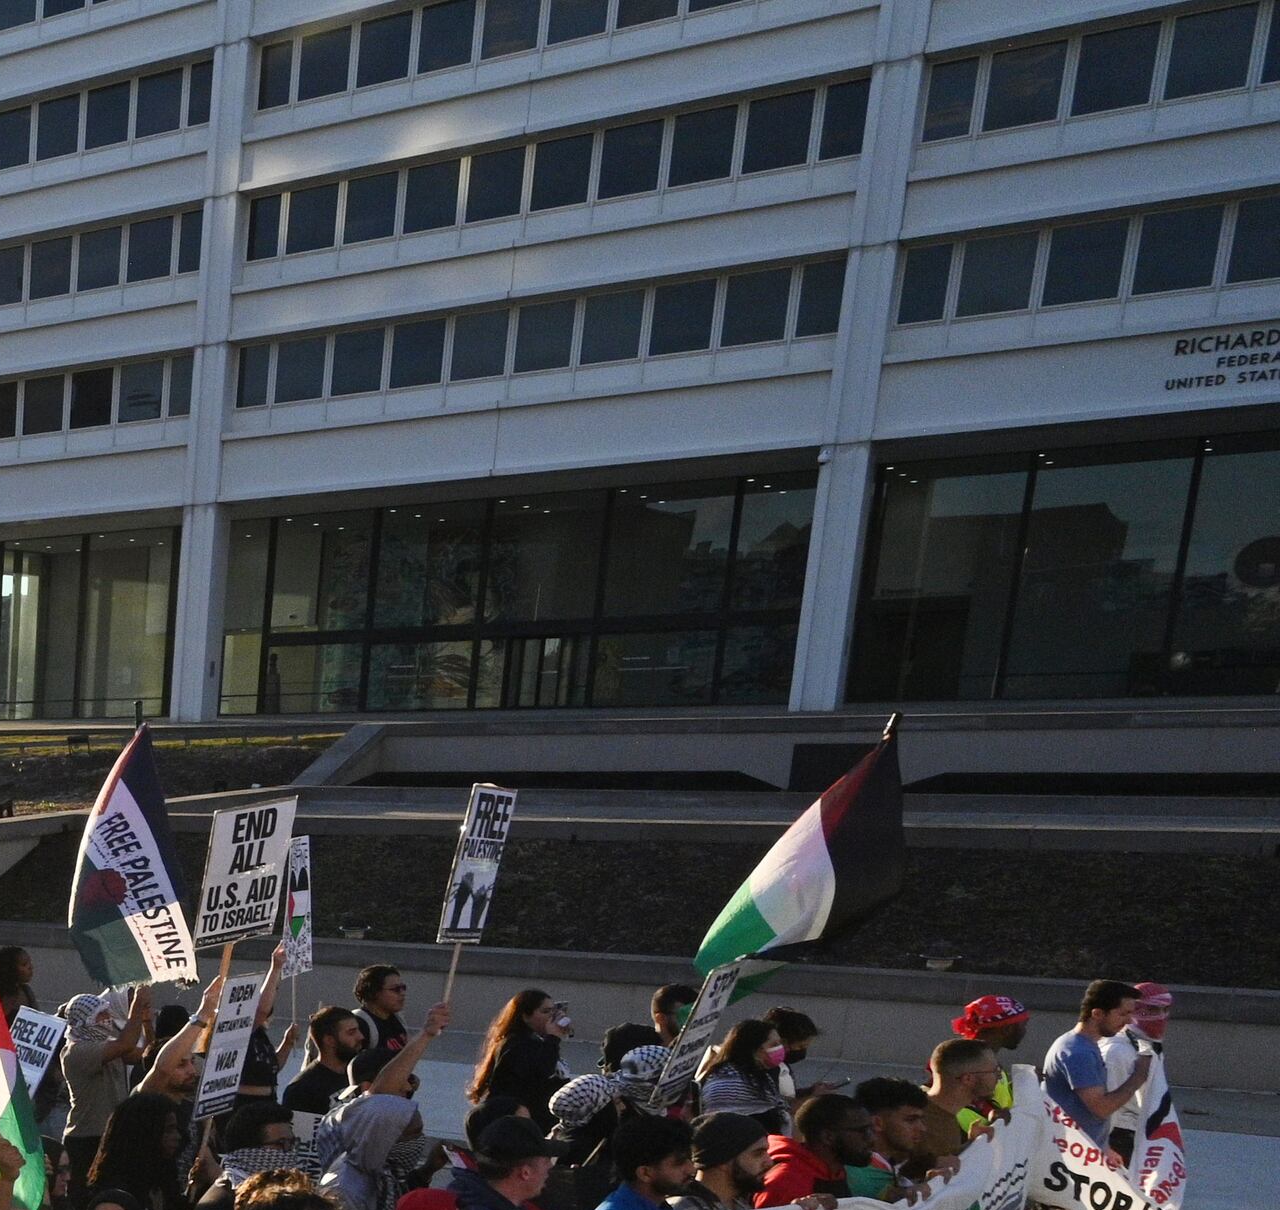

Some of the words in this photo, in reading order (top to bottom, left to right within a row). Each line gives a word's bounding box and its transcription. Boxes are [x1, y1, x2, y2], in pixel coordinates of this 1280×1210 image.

[1174, 329, 1280, 356] RICHARD
[1165, 375, 1226, 390] UNITED
[232, 807, 277, 844] END
[469, 792, 513, 840] FREE
[229, 840, 266, 874] ALL
[461, 838, 504, 864] PALESTINE
[96, 812, 142, 858] FREE
[120, 857, 187, 970] PALESTINE
[206, 882, 240, 912] U.S.
[246, 875, 277, 905] AID
[202, 912, 219, 933] TO
[221, 901, 274, 930] ISRAEL!
